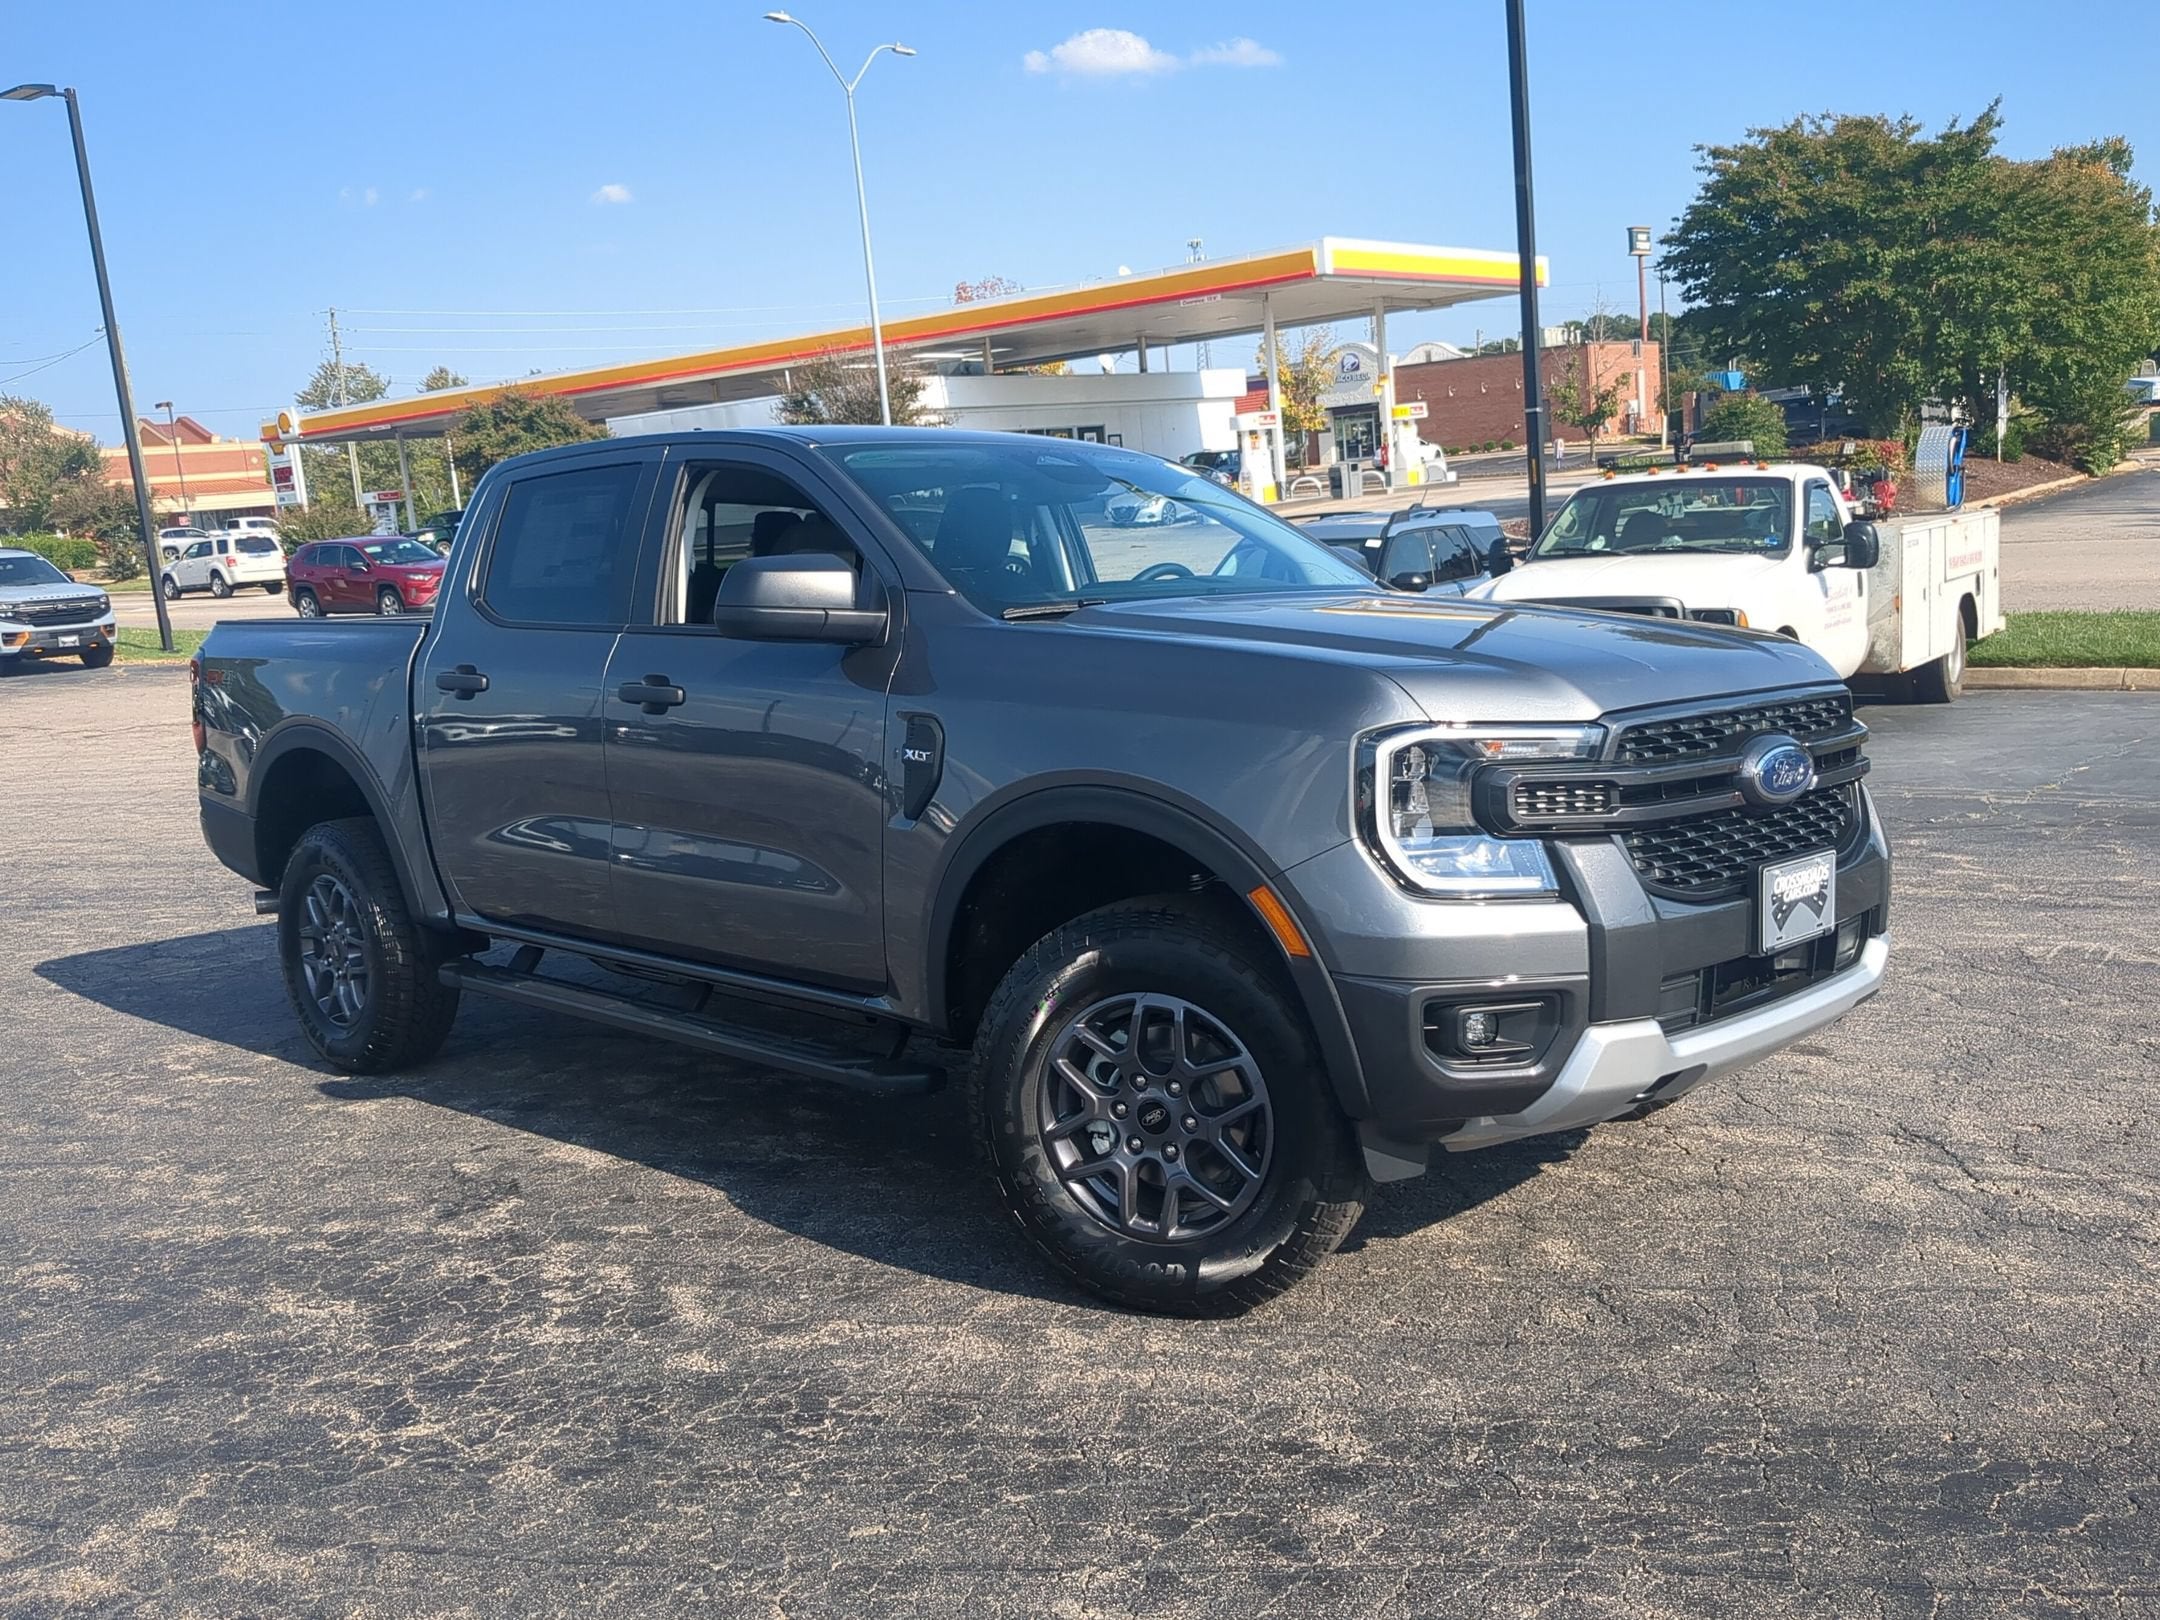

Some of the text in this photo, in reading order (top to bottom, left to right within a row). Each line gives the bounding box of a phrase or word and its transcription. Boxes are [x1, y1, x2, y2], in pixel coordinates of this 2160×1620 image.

[904, 748, 932, 762] XLT
[1772, 757, 1805, 788] Ford
[1773, 863, 1830, 896] CROSSROADS
[1783, 881, 1820, 902] CARS.COM
